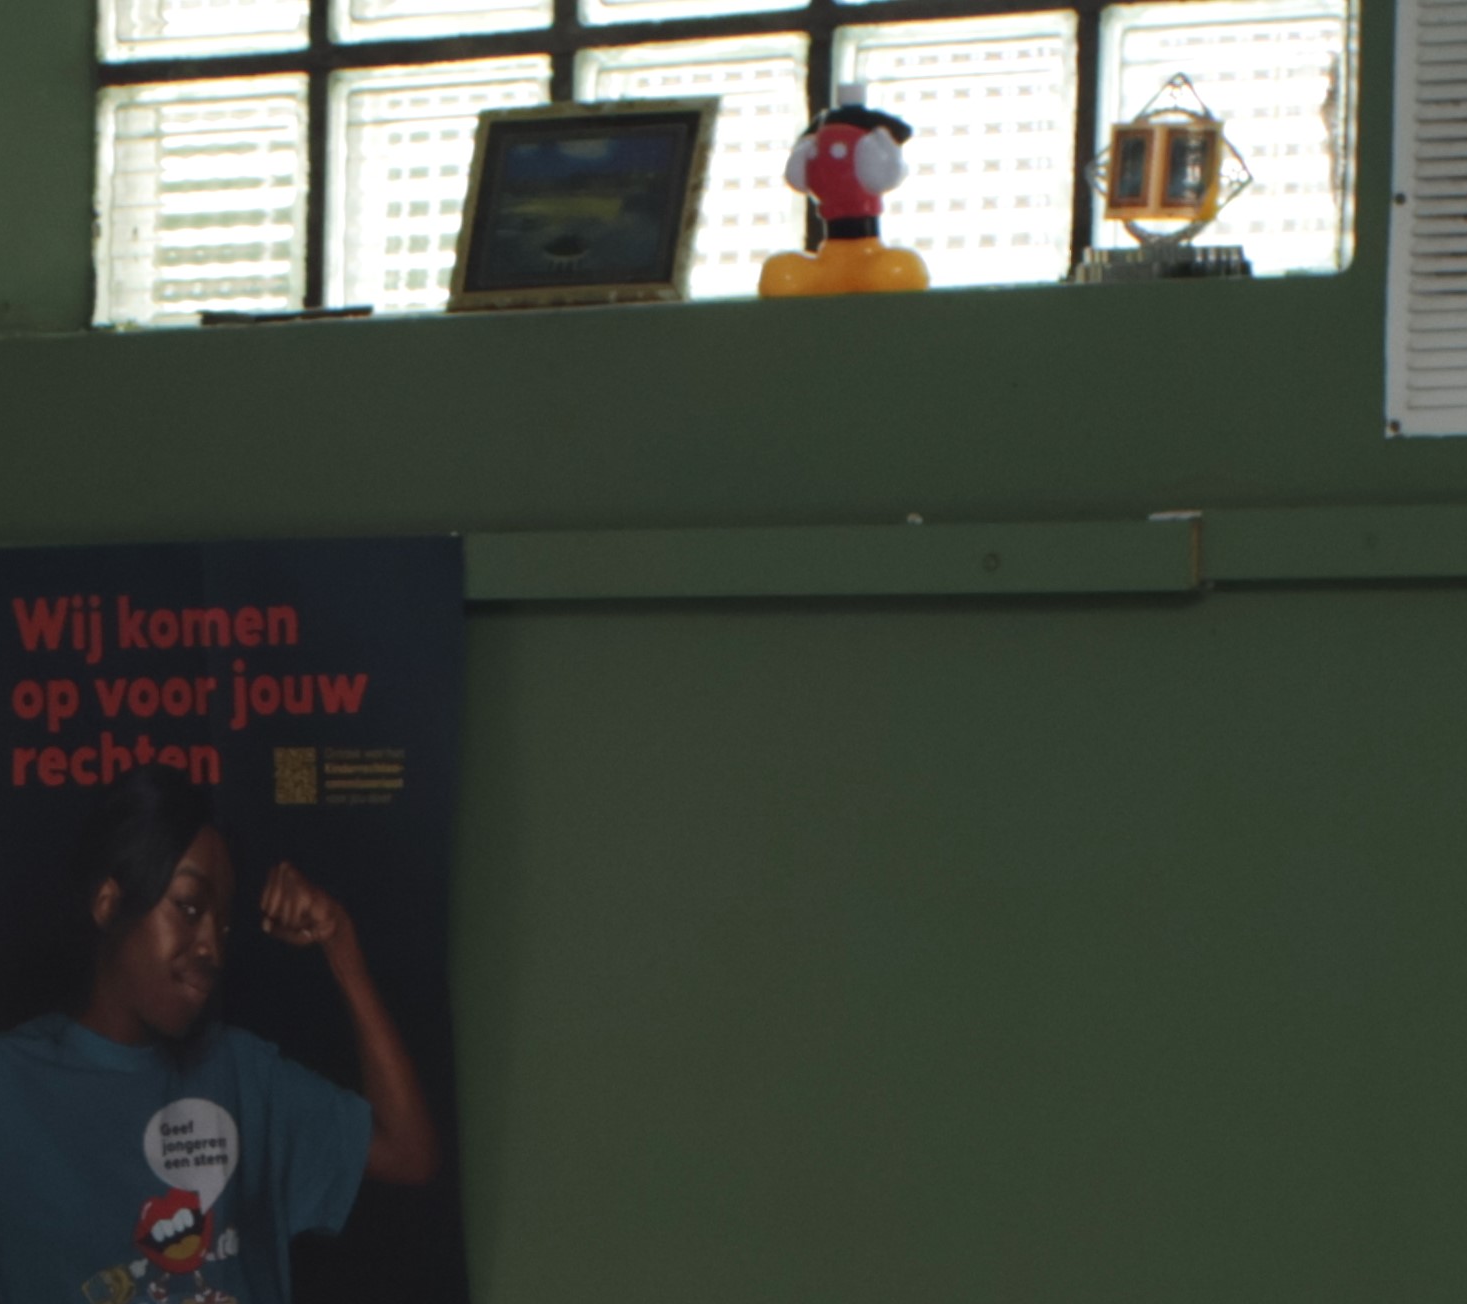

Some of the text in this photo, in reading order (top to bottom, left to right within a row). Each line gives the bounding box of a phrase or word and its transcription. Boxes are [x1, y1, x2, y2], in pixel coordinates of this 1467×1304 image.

[11, 595, 299, 664] Wij komen
[11, 659, 369, 732] op voor jouw
[159, 1120, 194, 1137] Geef
